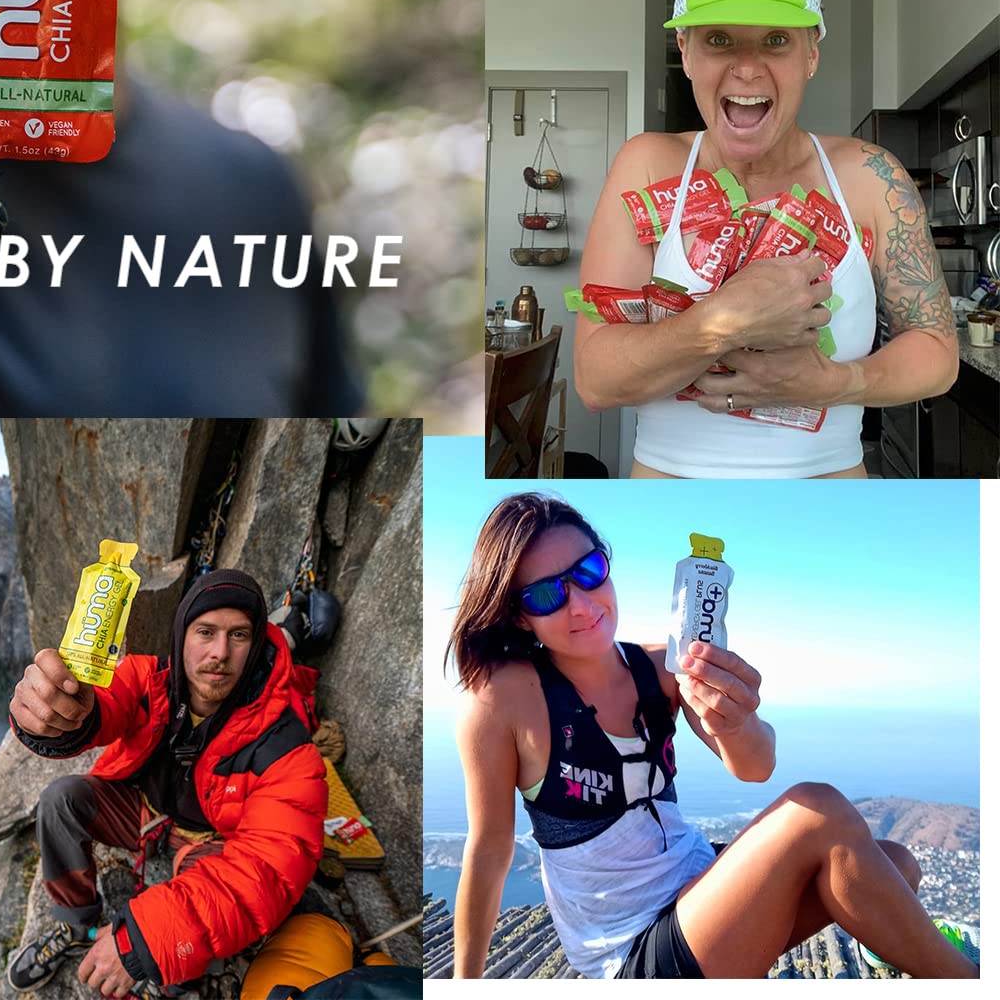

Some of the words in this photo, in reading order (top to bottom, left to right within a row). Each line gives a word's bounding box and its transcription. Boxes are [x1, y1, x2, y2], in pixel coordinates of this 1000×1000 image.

[50, 1, 72, 63] CHIA
[48, 121, 73, 129] VEGAN
[48, 129, 81, 137] FRIENDLY
[96, 629, 108, 649] CHIA
[102, 596, 117, 628] ENERGY
[113, 580, 124, 594] GEL
